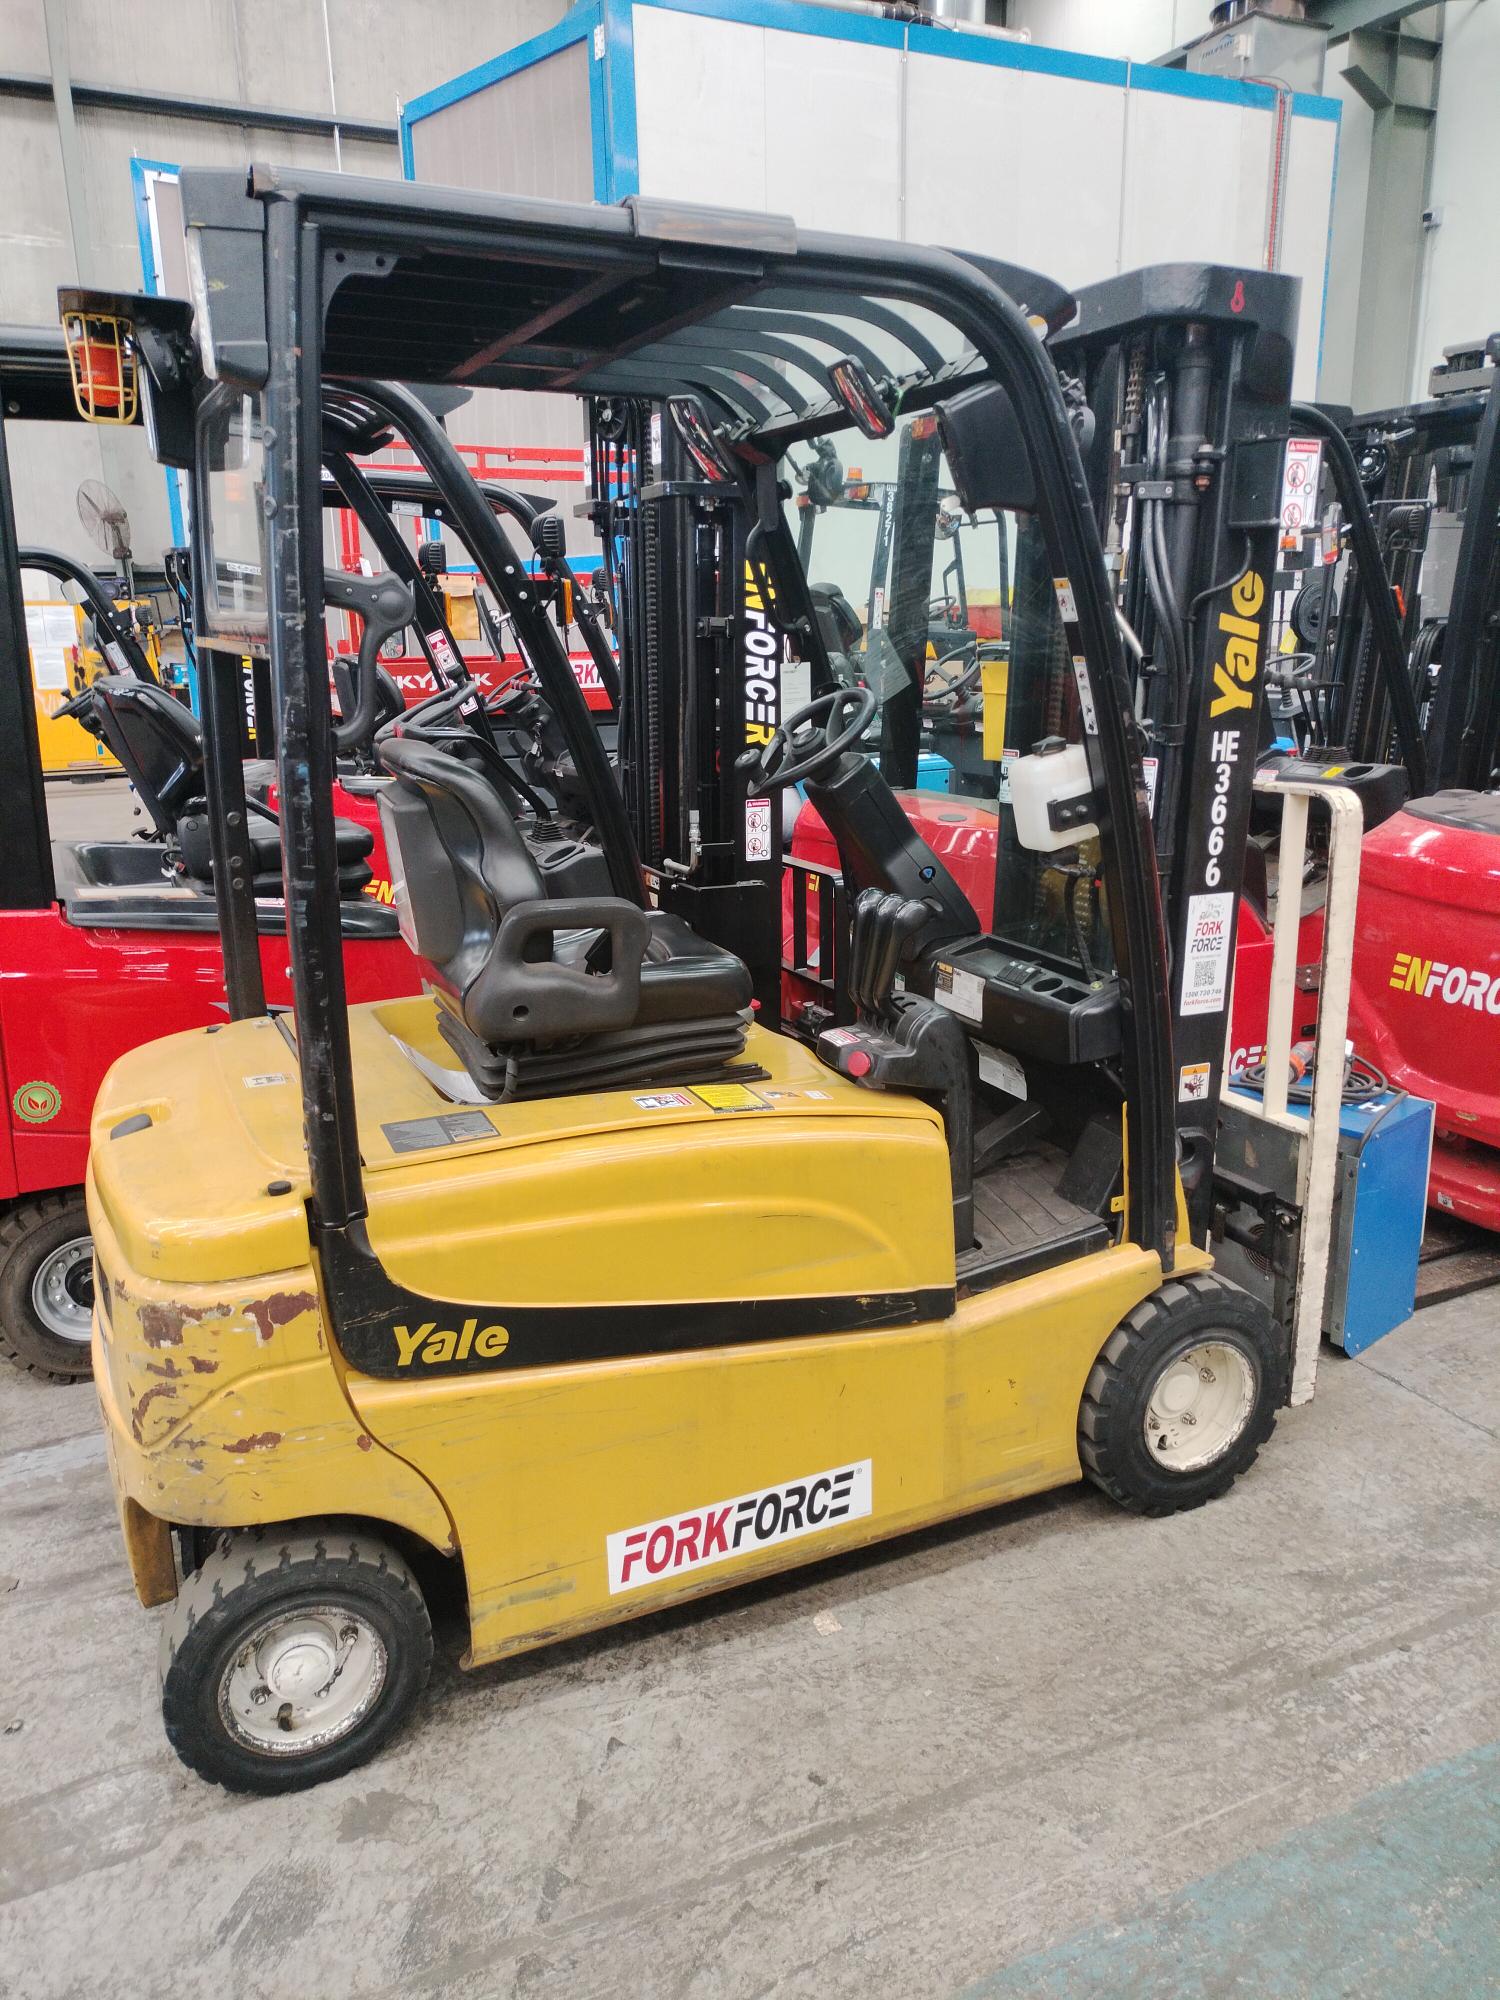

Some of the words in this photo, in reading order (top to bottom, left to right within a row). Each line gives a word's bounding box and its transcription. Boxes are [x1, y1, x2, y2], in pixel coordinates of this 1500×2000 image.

[1210, 570, 1264, 718] Yale
[1191, 936, 1224, 953] FORCE
[1195, 920, 1223, 936] FORK
[393, 1318, 510, 1367] Yale
[621, 1469, 855, 1584] FORKFORCE
